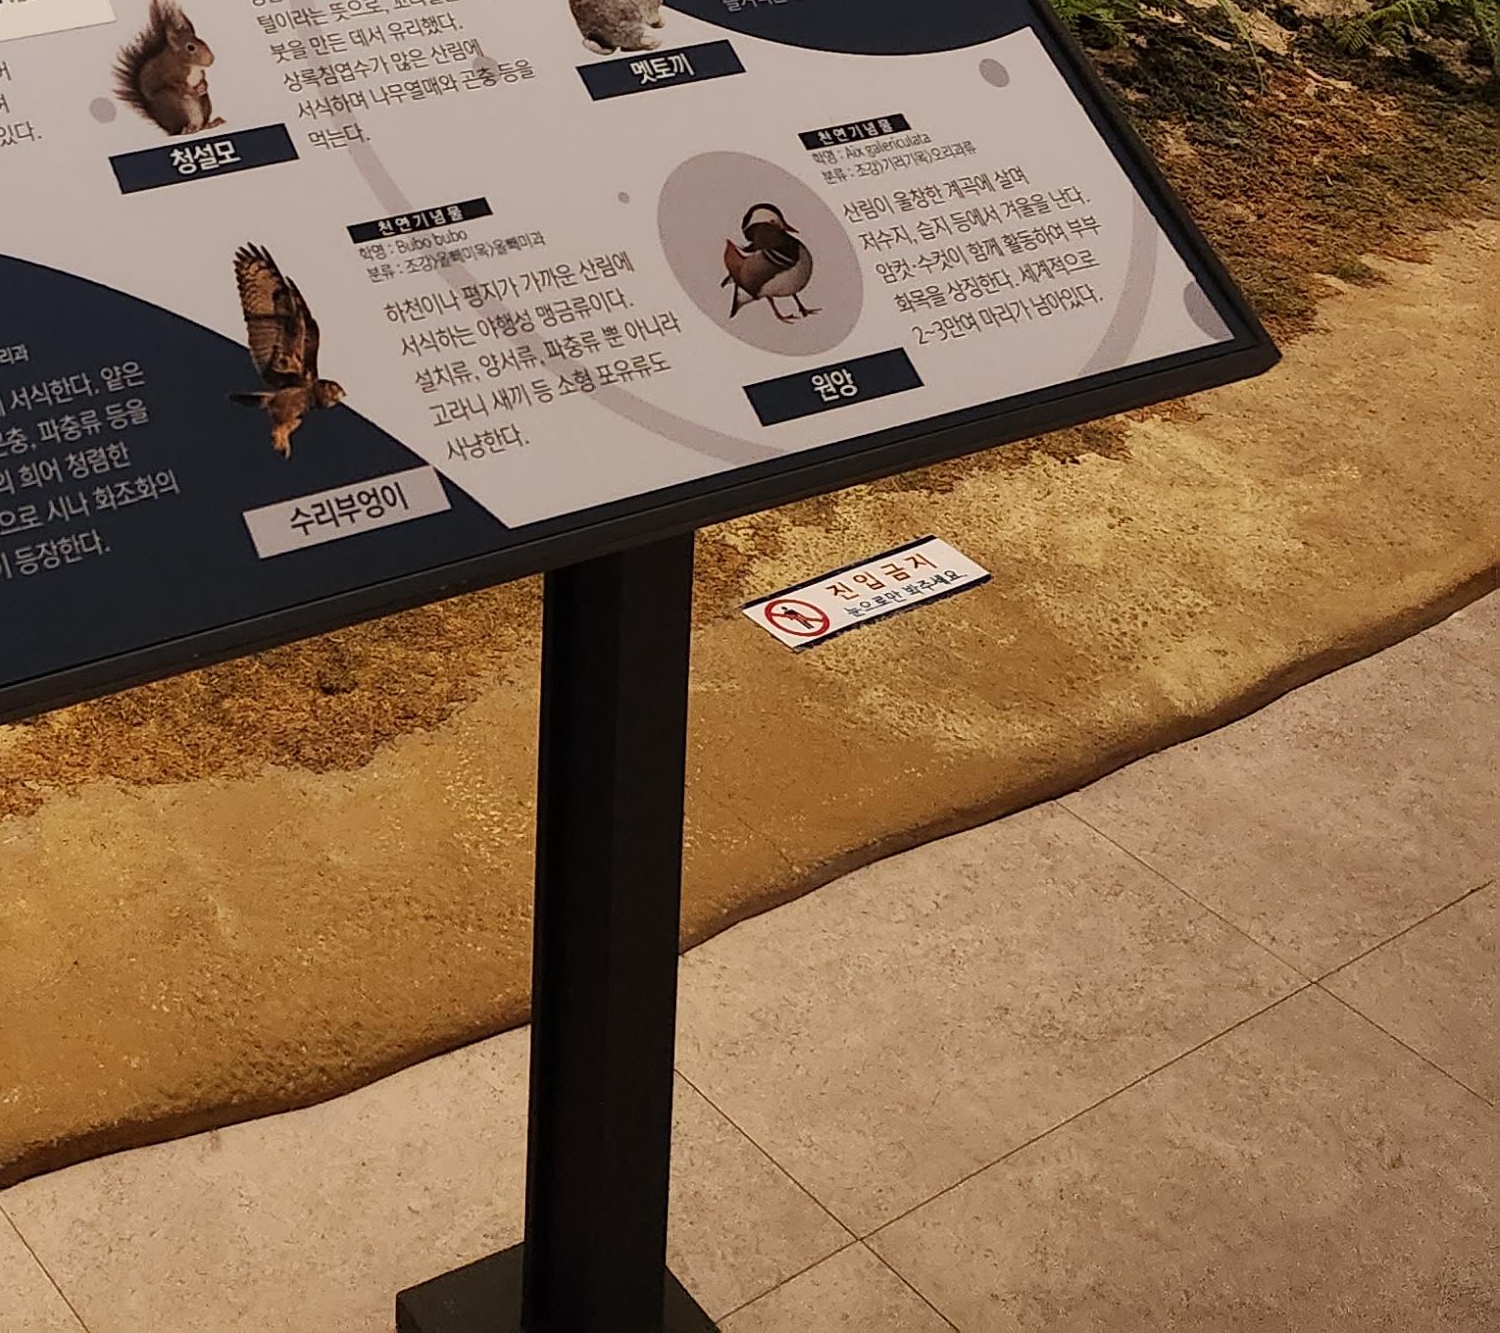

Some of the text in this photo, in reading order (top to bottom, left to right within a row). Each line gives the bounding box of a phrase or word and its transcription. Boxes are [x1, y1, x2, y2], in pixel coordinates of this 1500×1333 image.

[255, 6, 329, 35] 털이라는
[268, 38, 309, 64] 붓을
[307, 31, 348, 56] 만든
[347, 24, 387, 47] 데서
[282, 37, 485, 93] 상록침엽수가 많은 산림에
[628, 52, 695, 85] 멧토끼
[169, 139, 241, 175] 청설모
[306, 121, 371, 150] 먹는다.
[844, 146, 865, 159] Aix
[842, 164, 1030, 224] 산림이 울창한 계곡에 살며
[394, 236, 432, 254] Bubo
[430, 228, 468, 246] bubo
[856, 184, 1091, 252] 저수지, 습지 등에서 겨울을 난다.
[382, 250, 635, 324] 하천이나 평지가 가까운 산림에
[892, 248, 1101, 313] 화목을 상징한다. 세계적으로
[400, 286, 634, 357] 서식하는 야행성 맹금류이다.
[976, 298, 1033, 328] 마리가
[1027, 282, 1104, 317] 남아있다.
[414, 310, 682, 394] 설치류, 양서류, 파충류 뿐 아니라
[427, 350, 672, 427] 고라니 새끼 등 소형 포유류도
[810, 367, 858, 402] 원앙
[63, 440, 131, 479] 청렴한
[445, 422, 530, 461] 사냥한다.
[46, 490, 90, 522] 시나
[91, 468, 180, 510] 화조화의
[289, 480, 409, 536] 수리부엉이
[13, 528, 111, 575] 등장한다.
[825, 552, 938, 601] 진입금지
[844, 590, 907, 617] 눈으로만
